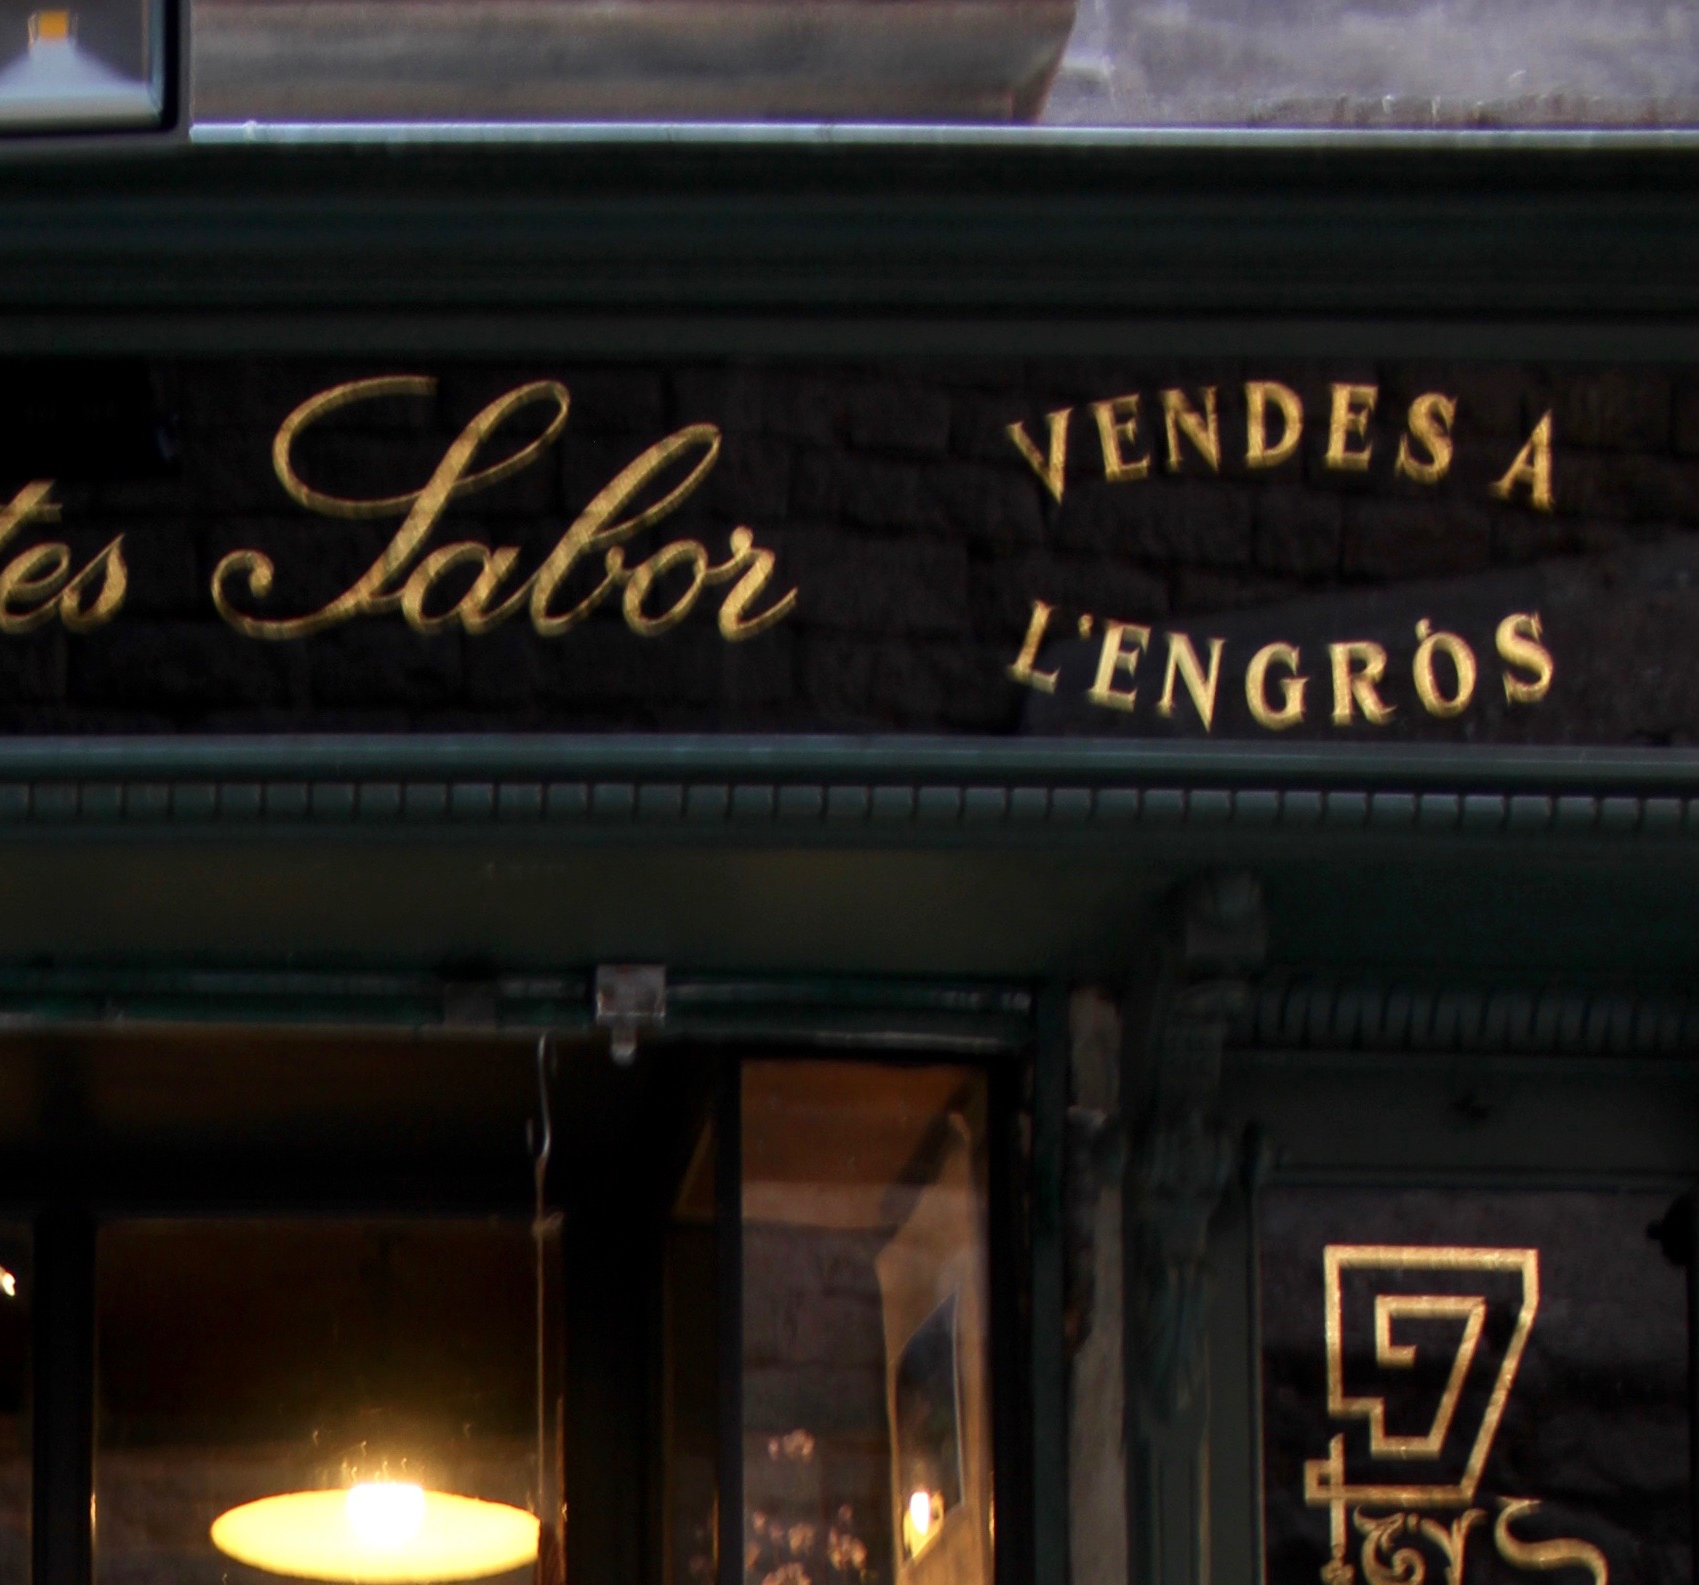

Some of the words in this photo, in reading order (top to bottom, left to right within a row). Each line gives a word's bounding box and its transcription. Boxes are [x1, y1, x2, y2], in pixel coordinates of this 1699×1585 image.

[211, 375, 798, 642] Labor
[1008, 380, 1459, 504] VENDES
[1493, 409, 1555, 511] A
[1008, 600, 1556, 732] L'ENGRÒS
